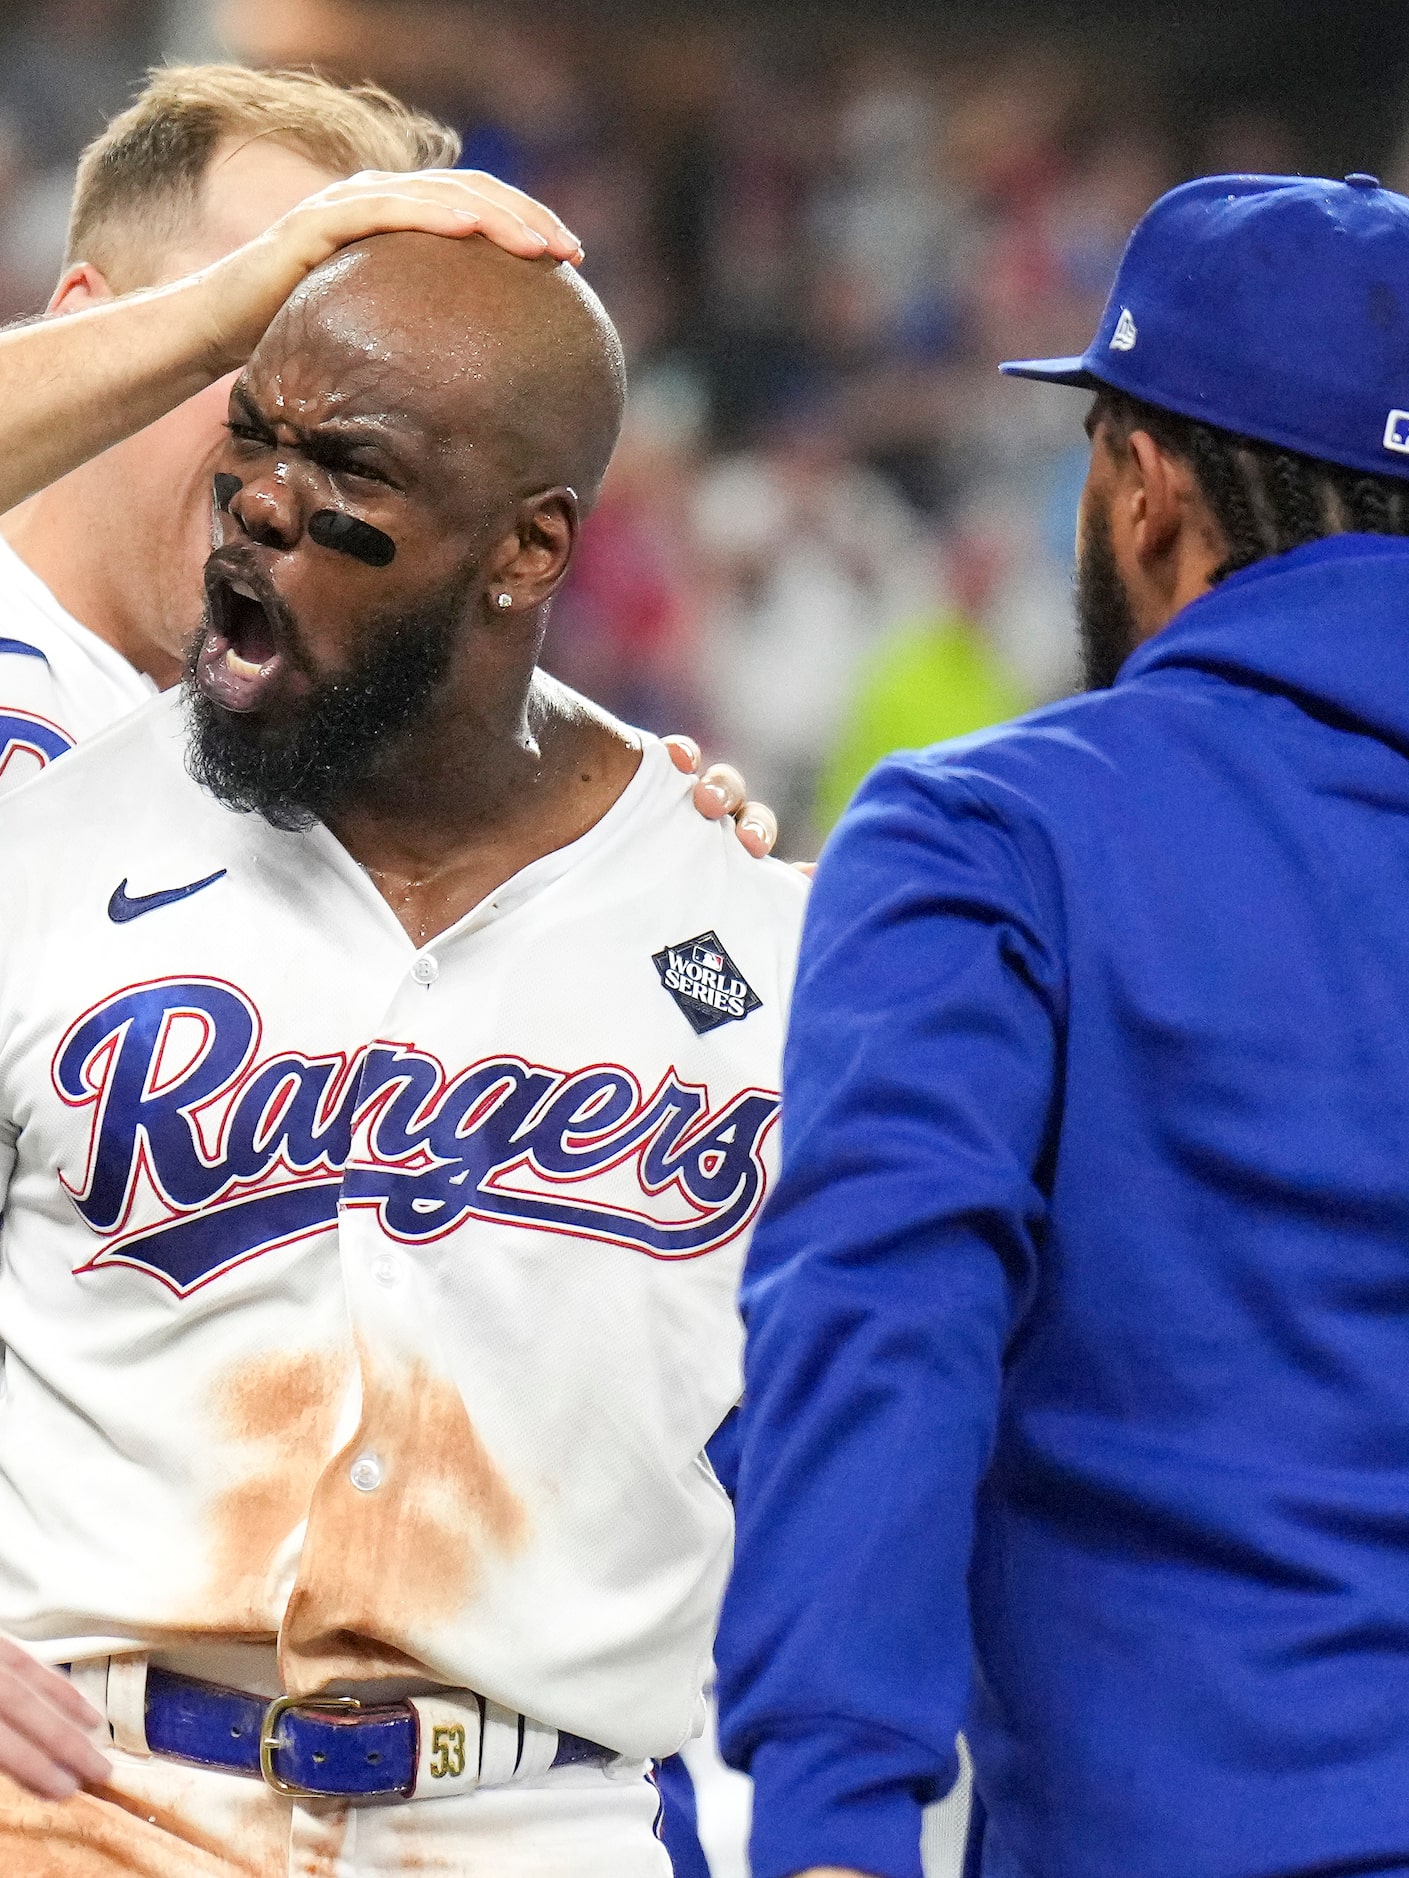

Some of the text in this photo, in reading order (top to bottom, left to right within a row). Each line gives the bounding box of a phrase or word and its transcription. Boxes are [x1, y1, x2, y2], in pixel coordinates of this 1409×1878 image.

[664, 968, 745, 1017] SERIES
[667, 949, 747, 999] WORLD
[52, 974, 782, 1298] Rangers
[430, 1723, 466, 1779] 53
